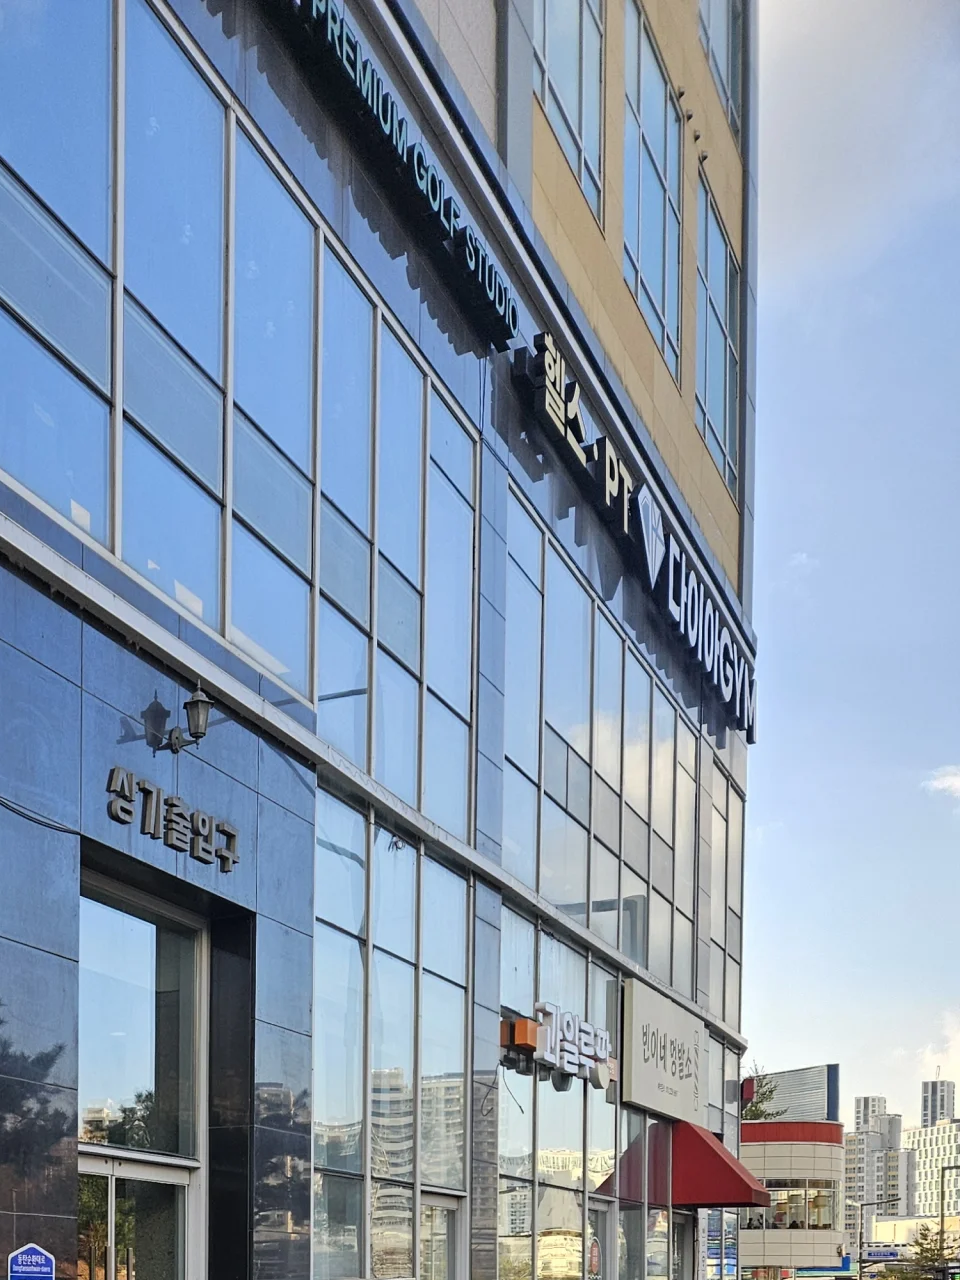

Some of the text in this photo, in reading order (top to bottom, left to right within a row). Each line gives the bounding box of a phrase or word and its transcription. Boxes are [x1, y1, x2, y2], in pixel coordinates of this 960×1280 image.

[414, 142, 460, 238] GOLF
[466, 225, 519, 338] STUDIO
[669, 534, 757, 744] 다이아GYM
[642, 1023, 668, 1073] 빈이네
